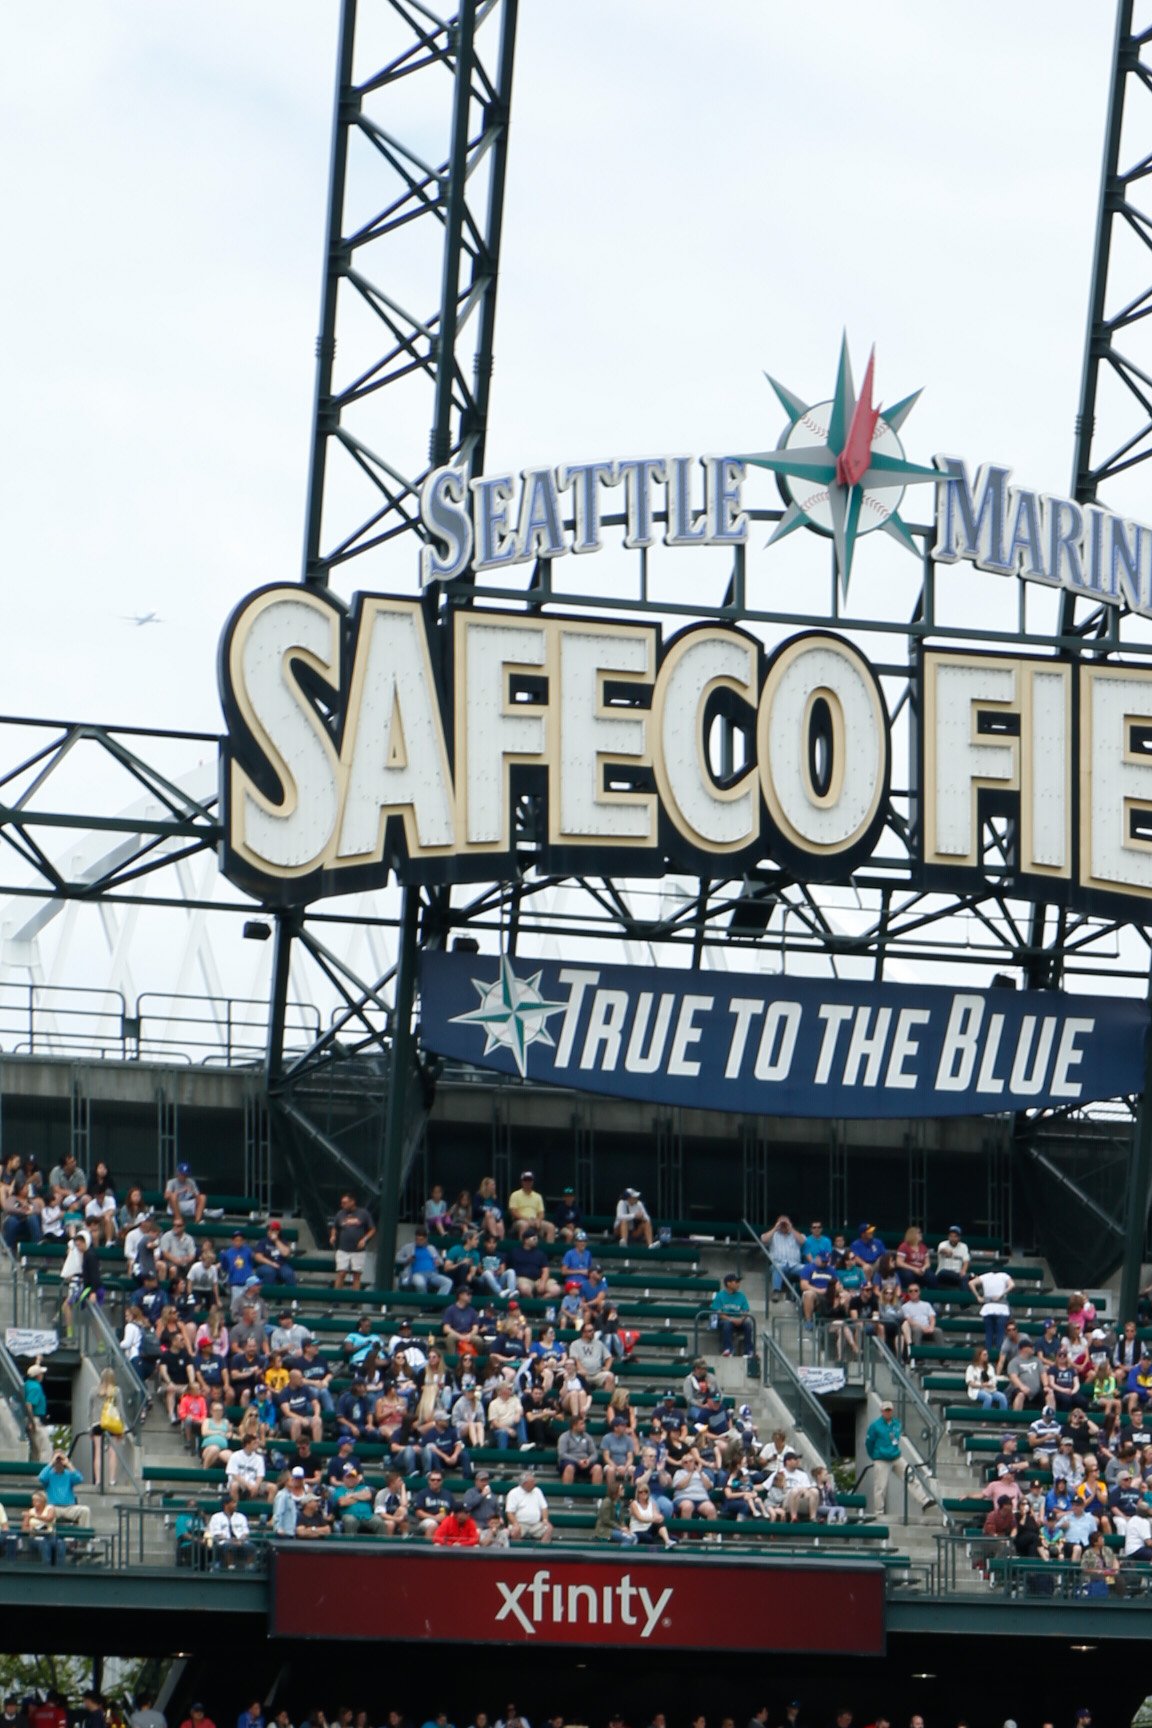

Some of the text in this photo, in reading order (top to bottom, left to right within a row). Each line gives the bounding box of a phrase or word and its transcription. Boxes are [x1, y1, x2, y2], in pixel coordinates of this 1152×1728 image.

[420, 454, 749, 587] SEATTLE
[226, 586, 888, 884] SAFECO
[553, 968, 1095, 1097] TRUE TO THE BLUE
[495, 1571, 673, 1637] xfinity
